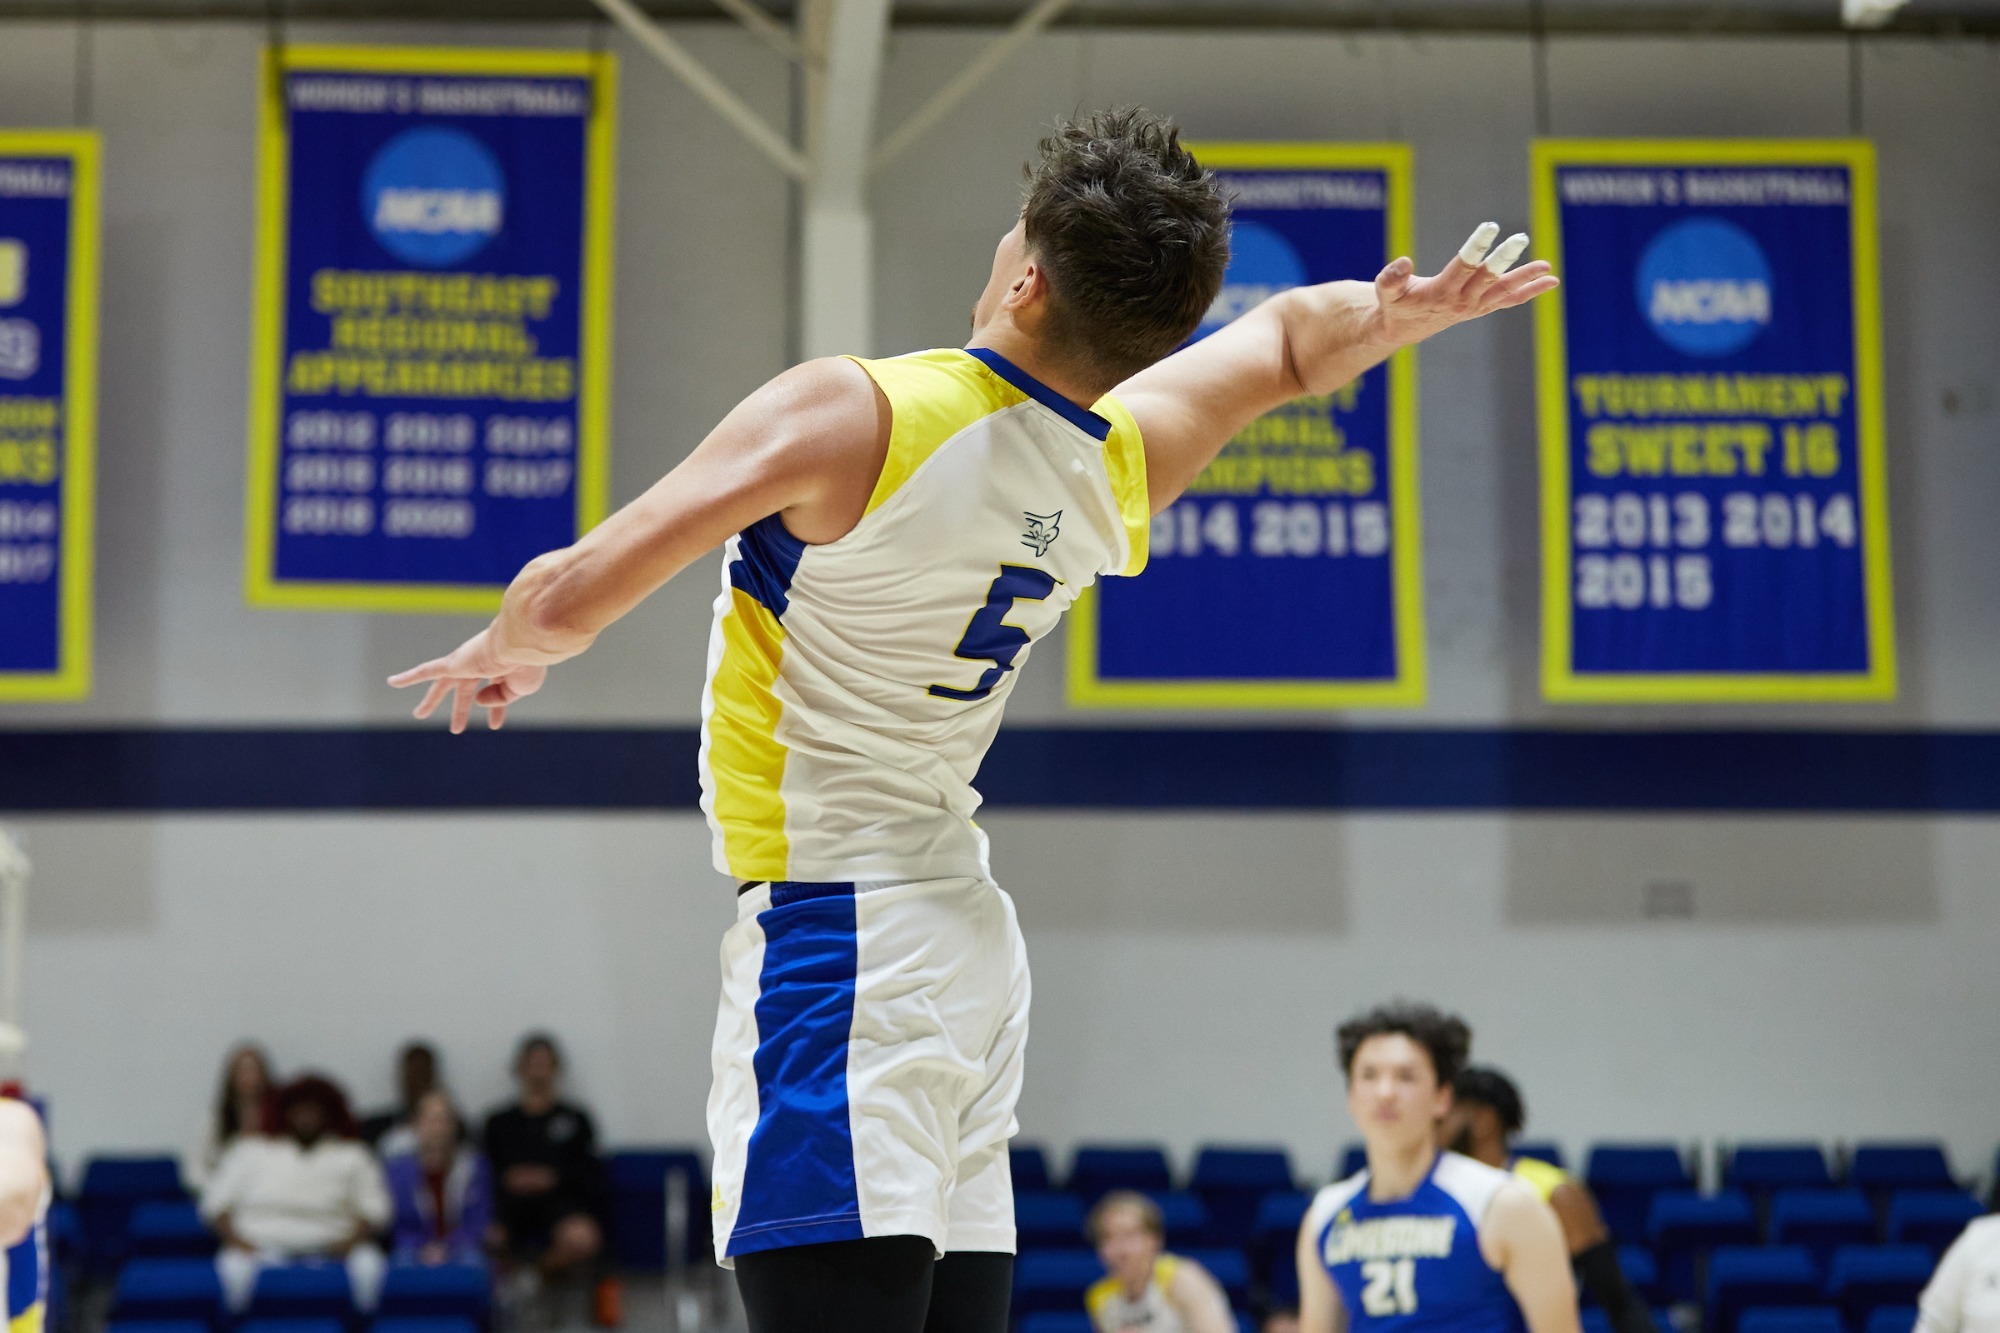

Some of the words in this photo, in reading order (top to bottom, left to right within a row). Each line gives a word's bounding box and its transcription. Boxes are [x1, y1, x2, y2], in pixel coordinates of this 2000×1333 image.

[420, 81, 584, 116] BASKETBALL
[376, 187, 502, 234] NCAA
[1562, 170, 1679, 206] WOMEN'S
[1683, 171, 1846, 206] BASKETBALL
[311, 268, 559, 320] SOUTHEAST
[1650, 278, 1771, 324] NCAA
[332, 316, 538, 355] REGIONAL
[289, 353, 574, 401] APPEARANCES
[1575, 372, 1847, 417] TOURNAMENT
[1586, 421, 1771, 478] SWEET
[1782, 421, 1840, 478] 16
[1148, 501, 1240, 557] 014
[1252, 501, 1388, 557] 2015
[1575, 492, 1710, 549] 2013
[1722, 492, 1855, 549] 2014
[1577, 553, 1712, 610] 2015
[926, 561, 1064, 702] 5
[1361, 1258, 1418, 1317] 21
